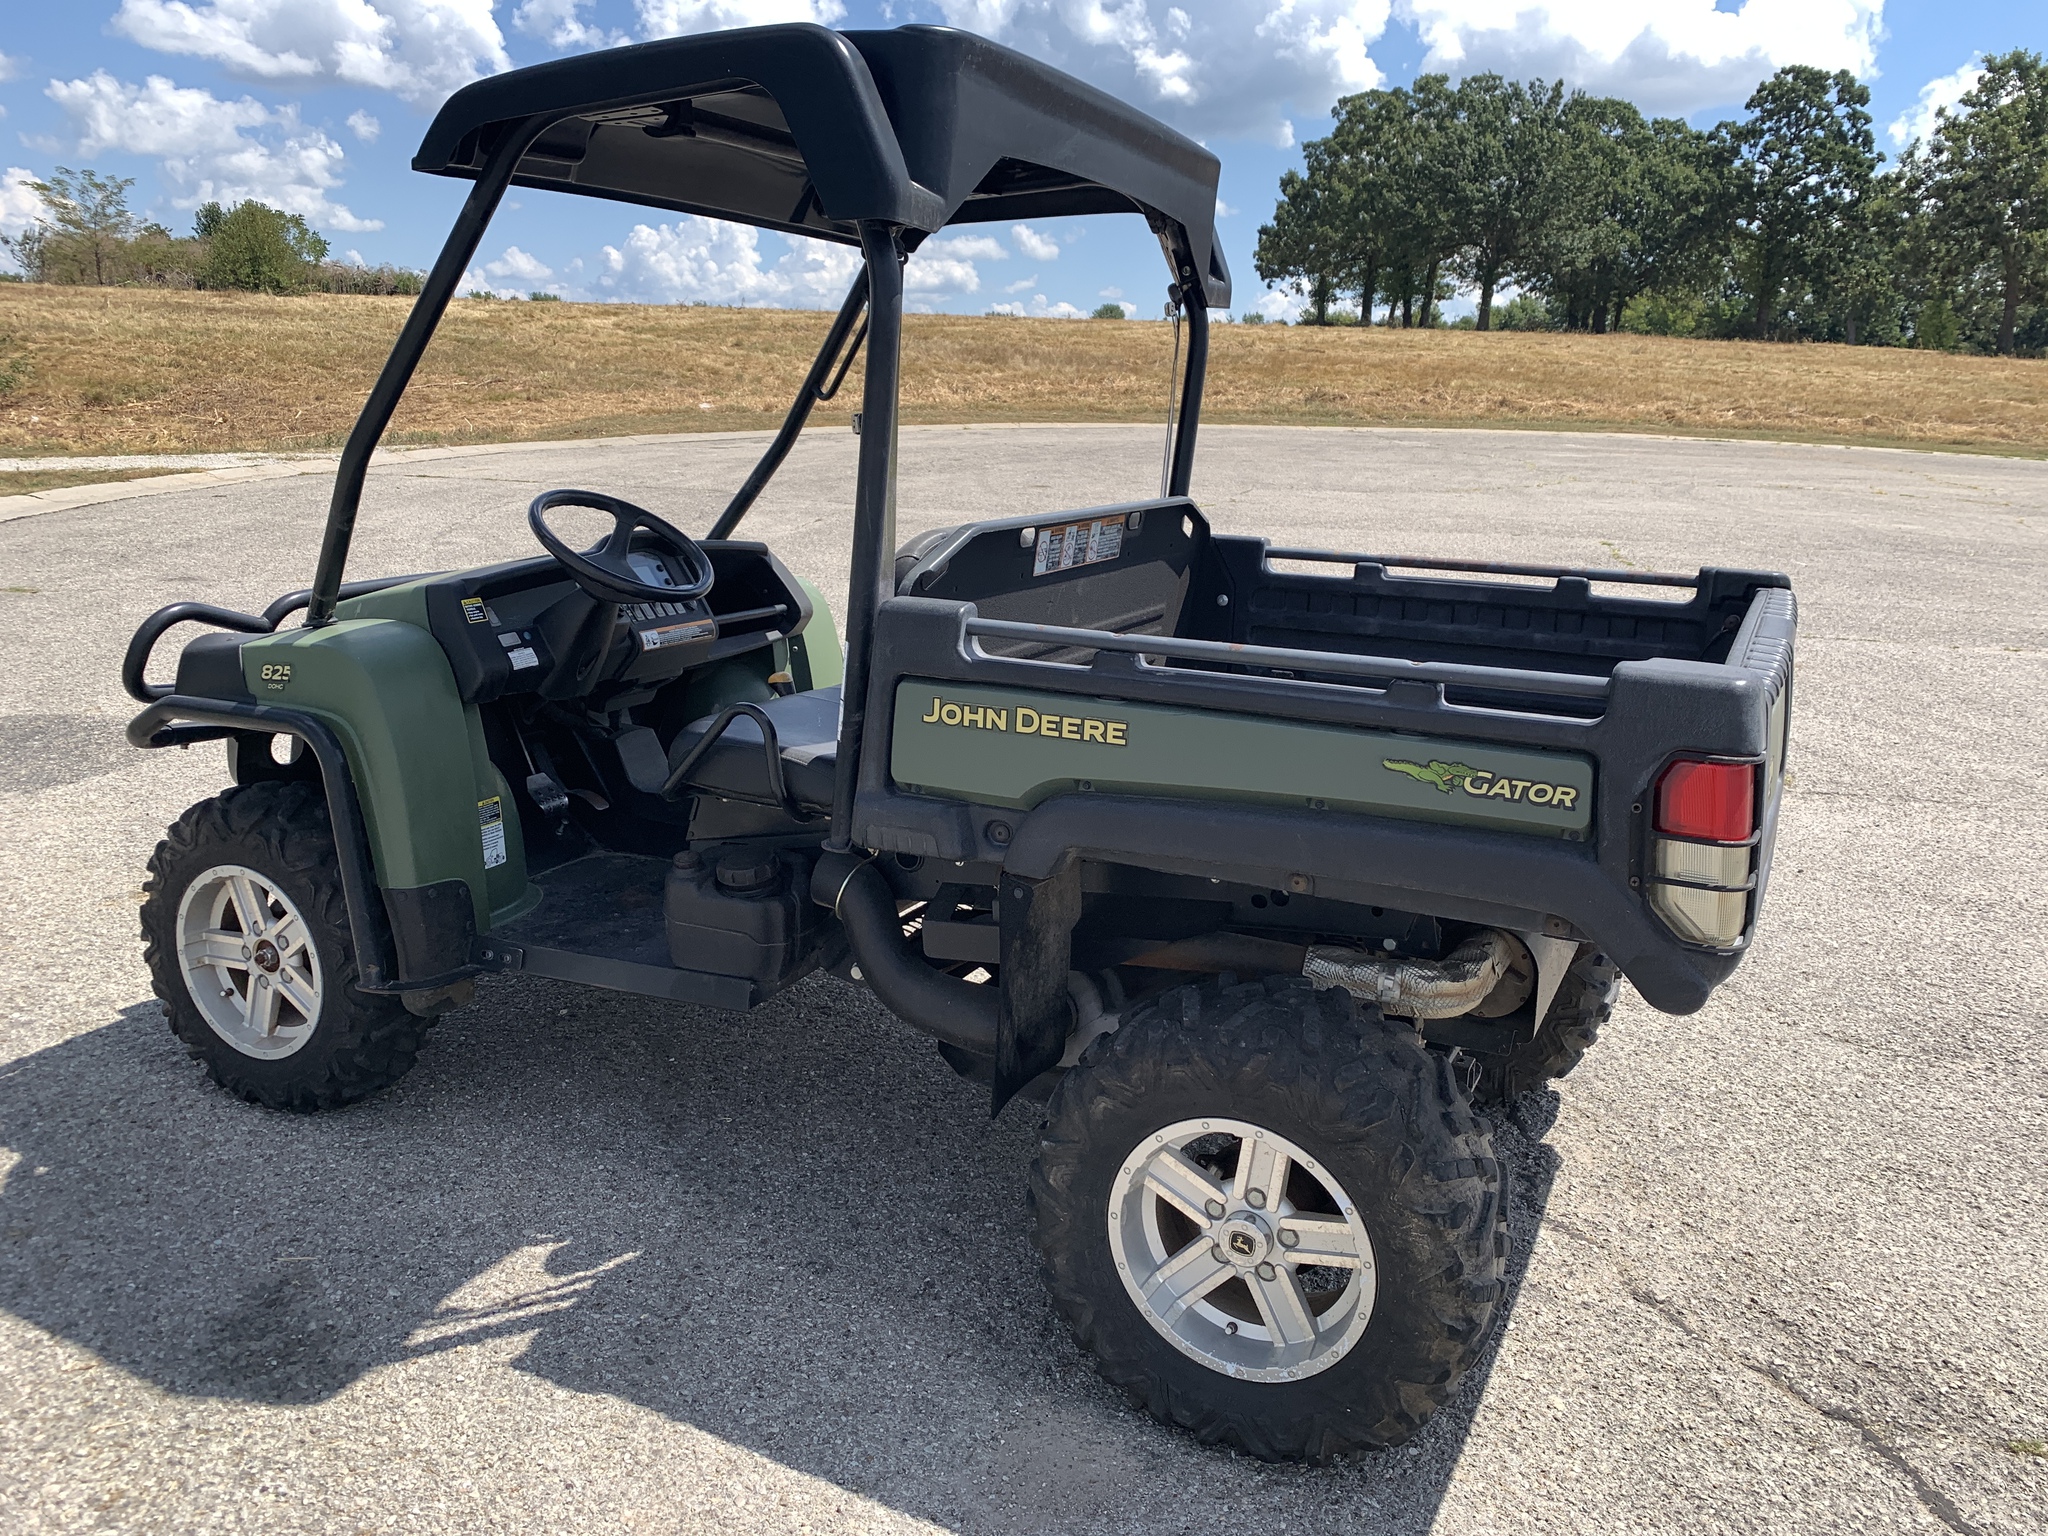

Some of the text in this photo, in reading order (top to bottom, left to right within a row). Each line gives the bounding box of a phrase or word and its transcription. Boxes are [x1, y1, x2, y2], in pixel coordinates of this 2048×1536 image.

[261, 664, 291, 680] 825
[922, 696, 1128, 746] JOHN DEERE
[1462, 770, 1578, 808] GATOR
